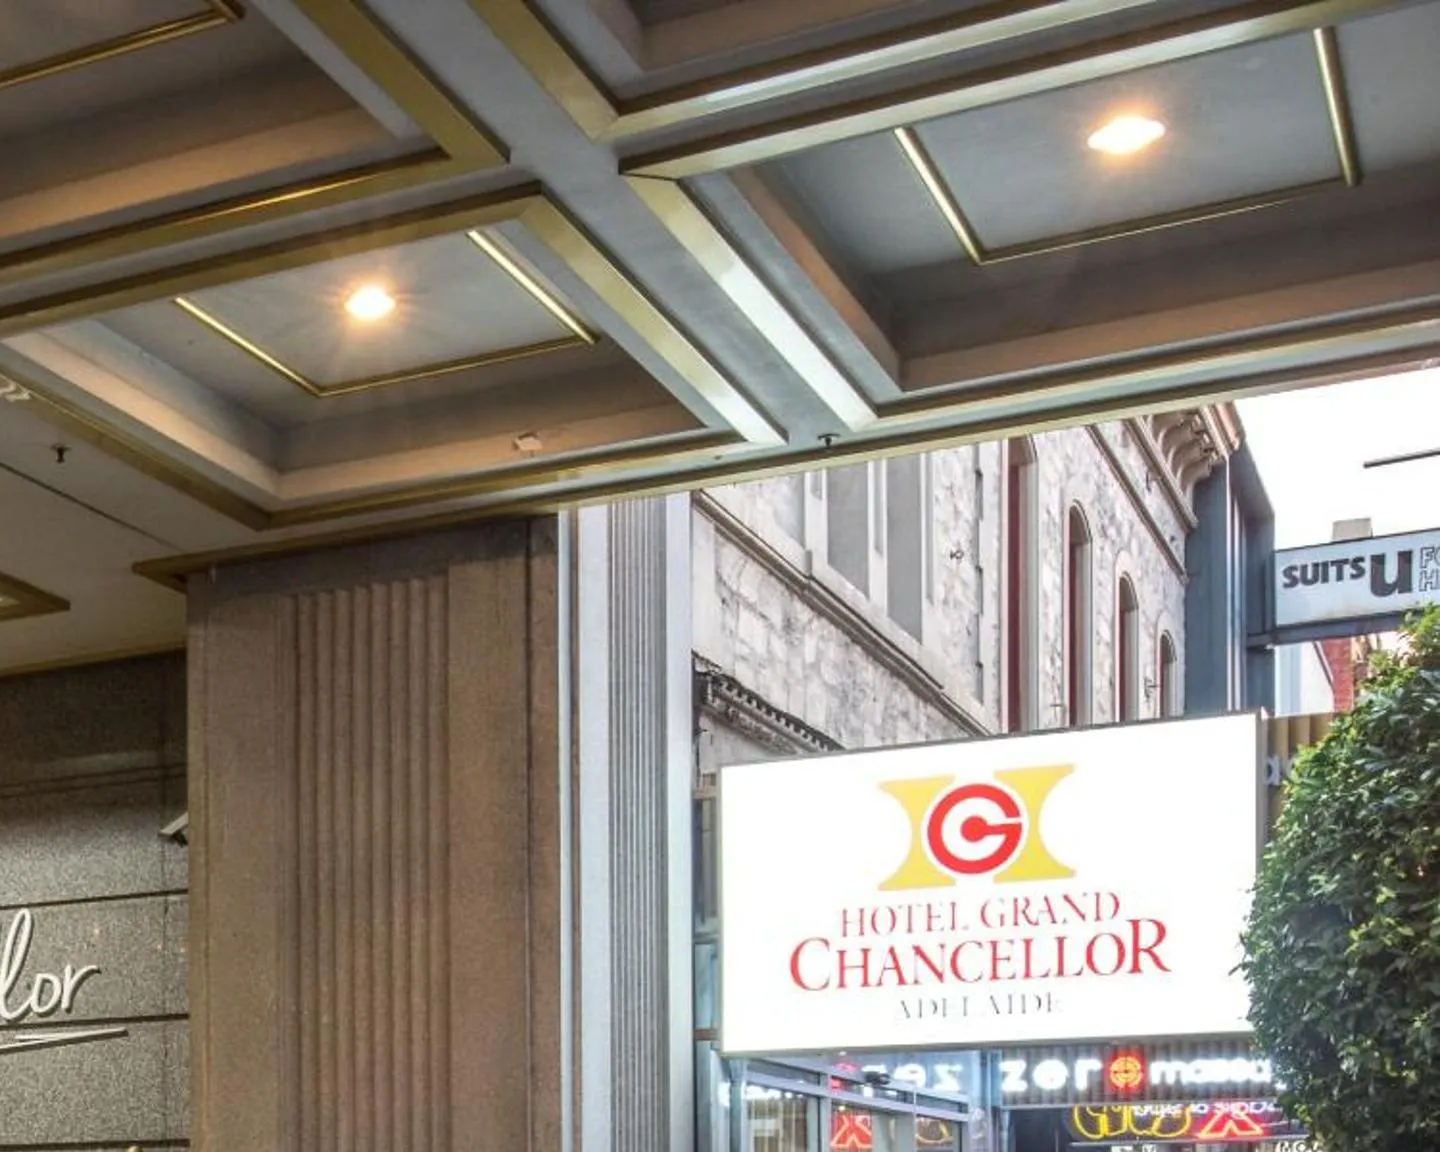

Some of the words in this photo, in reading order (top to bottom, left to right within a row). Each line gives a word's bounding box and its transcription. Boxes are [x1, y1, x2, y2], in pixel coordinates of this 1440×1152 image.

[1281, 556, 1366, 588] SUITS
[840, 900, 970, 939] HOTEL
[979, 891, 1122, 929] GRAND
[787, 917, 1173, 992] CHANCELLOR
[897, 991, 1064, 1021] ADELAIDE
